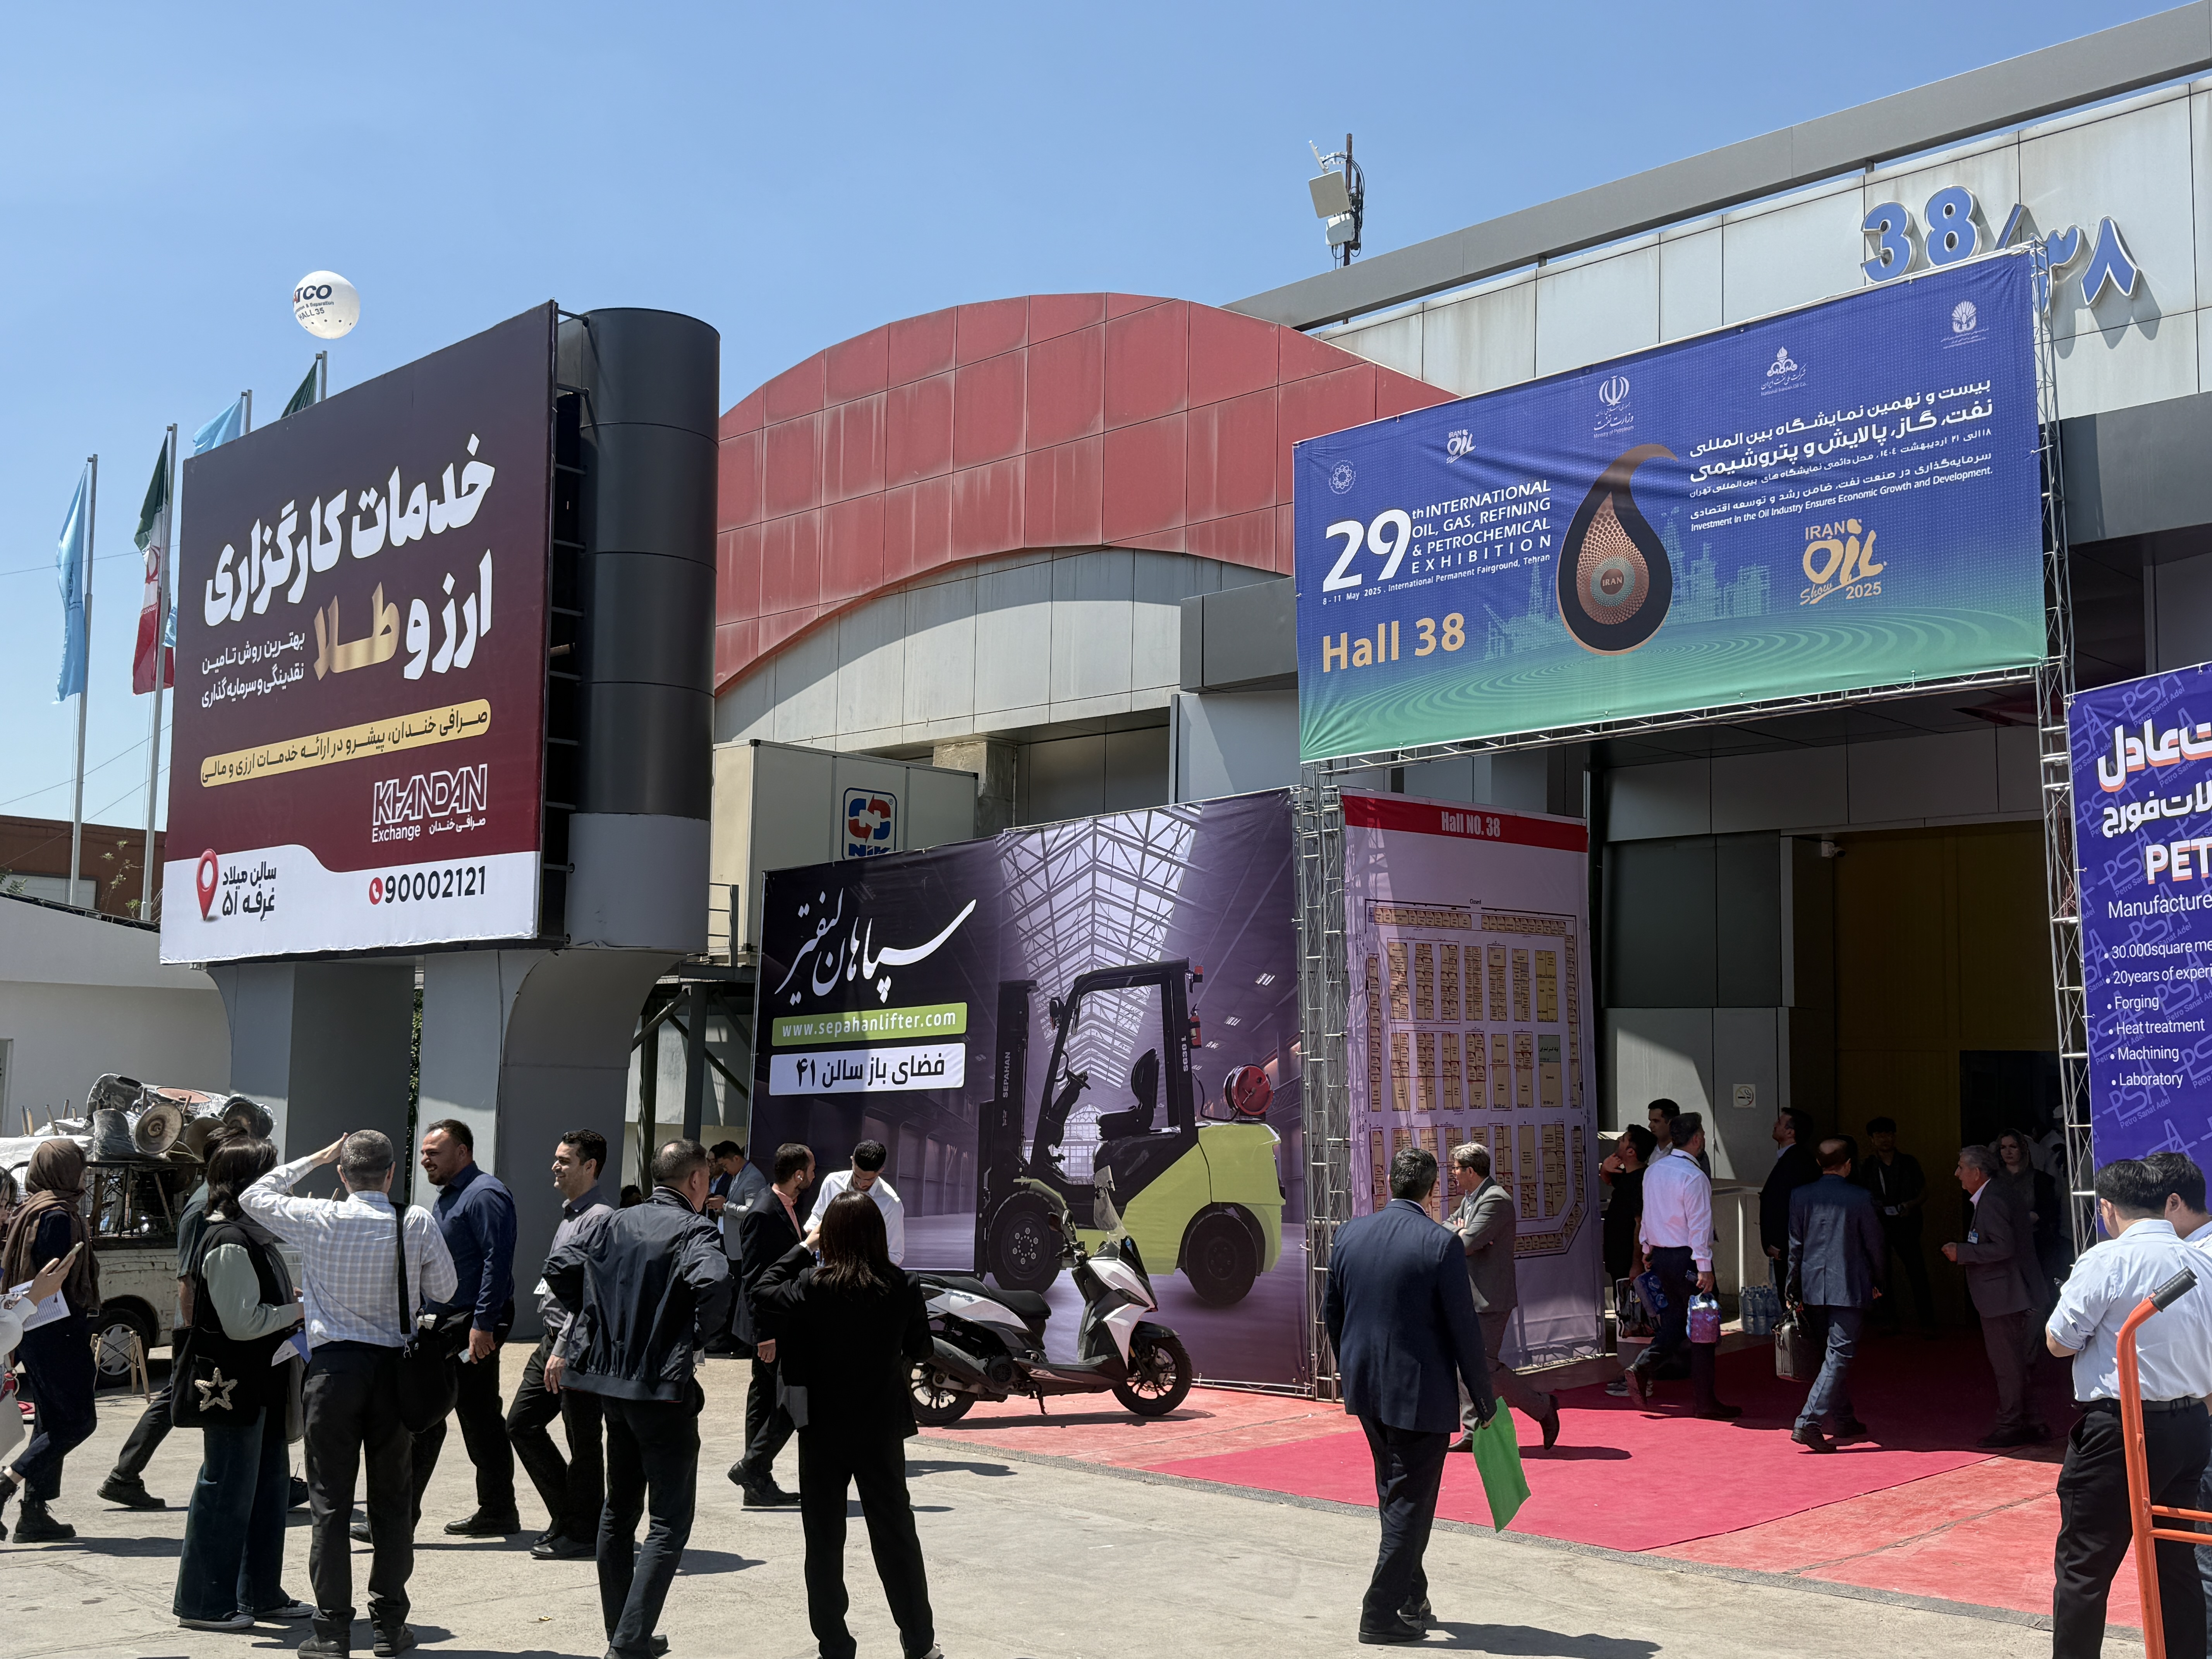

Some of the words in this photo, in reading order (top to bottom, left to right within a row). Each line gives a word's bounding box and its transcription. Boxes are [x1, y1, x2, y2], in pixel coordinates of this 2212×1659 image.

[298, 310, 315, 320] HALL
[1925, 392, 1935, 405] و
[1938, 380, 1990, 399] بیست
[1867, 392, 1920, 417] نهمین
[1594, 414, 1612, 431] نفت
[1610, 413, 1634, 427] وزارت
[1776, 405, 1864, 435] نمایشگاه
[1449, 429, 1462, 438] IRAN
[1690, 432, 1743, 457] المللی
[1746, 429, 1772, 444] بین
[1818, 424, 1887, 455] پالایش
[1901, 437, 1947, 453] اردیبهشت
[1803, 441, 1815, 458] و
[1852, 454, 1874, 464] محل
[1690, 443, 1798, 483] پتروشیمی
[1780, 463, 1822, 478] نمایشگاه
[1899, 468, 1910, 478] در
[1863, 471, 1896, 484] صنعت
[351, 434, 495, 558] خدمات
[1426, 479, 1551, 518] INTERNATIONAL
[1690, 486, 1711, 498] تهران
[1691, 517, 1732, 532] Investment
[1734, 515, 1741, 523] in
[1743, 513, 1756, 522] the
[1758, 510, 1769, 519] Oil
[1771, 503, 1803, 516] Industry
[1805, 497, 1836, 509] Ensures
[1838, 488, 1878, 503] Economic
[1880, 482, 1911, 495] Growth
[1914, 477, 1930, 489] and
[1933, 466, 1993, 485] Development.
[1779, 489, 1800, 501] رشد
[1803, 483, 1832, 497] ضامن
[1690, 503, 1730, 520] اقتصادی
[1733, 496, 1766, 509] توسعه
[1412, 524, 1439, 538] OIL,
[1443, 515, 1475, 531] GAS,
[1480, 497, 1550, 524] REFINING
[1412, 544, 1422, 556] &
[1427, 517, 1551, 554] PETROCHEMICAL
[1805, 520, 1845, 540] IRAN
[205, 489, 347, 626] کارگزاری
[1412, 534, 1551, 574] EXHIBITION
[1346, 592, 1360, 600] May
[1364, 587, 1381, 596] 2025
[1388, 576, 1433, 592] International
[1436, 568, 1474, 582] Permanent
[1477, 559, 1520, 575] Fairground,
[1523, 554, 1550, 565] Tehran
[1602, 577, 1622, 587] IRAN
[1800, 582, 1833, 605] Show
[1846, 582, 1882, 599] 2025
[432, 548, 492, 673] ارز
[314, 581, 400, 680] طلا
[404, 599, 430, 680] و
[238, 641, 262, 665] روش
[264, 632, 305, 658] بهترین
[1322, 620, 1400, 673] Hall
[1415, 613, 1465, 656] 38
[203, 647, 236, 675] تامین
[258, 678, 263, 696] و
[264, 663, 304, 694] نقدینگی
[2133, 713, 2151, 728] Petro
[2151, 699, 2170, 716] Sanat
[2170, 685, 2185, 702] Adel
[440, 708, 488, 736] صرافی
[257, 745, 298, 767] خدمات
[331, 739, 343, 758] در
[202, 761, 226, 783] مالی
[229, 763, 233, 778] و
[236, 753, 255, 776] ارزی
[373, 763, 488, 826] KHANDAN
[372, 825, 421, 843] Exchange
[429, 818, 455, 835] خندان
[456, 814, 486, 832] صرافی
[1441, 811, 1464, 834] Hall
[1467, 816, 1484, 836] NO.
[1486, 817, 1501, 837] 38
[222, 866, 248, 890] میلاد
[250, 861, 276, 886] سالن
[385, 866, 486, 903] 90002121
[222, 890, 238, 916] ۵۱
[242, 884, 275, 922] غرفه
[2113, 970, 2159, 987] 20years
[2162, 966, 2174, 981] of
[2114, 994, 2159, 1012] Forging
[782, 1010, 956, 1038] www.sepahanlifter.com
[2117, 1021, 2143, 1035] Heat
[2145, 1018, 2205, 1034] treatment
[2118, 1045, 2179, 1062] Machining
[796, 1058, 816, 1087] ۴۱
[822, 1059, 863, 1088] سالن
[868, 1056, 887, 1086] باز
[891, 1053, 945, 1085] فضای
[1003, 1052, 1011, 1098] SEPAHAN
[2119, 1072, 2183, 1089] Laboratory
[2119, 1115, 2137, 1129] Petro
[2137, 1105, 2156, 1120] Sanat
[2156, 1095, 2171, 1109] Adel
